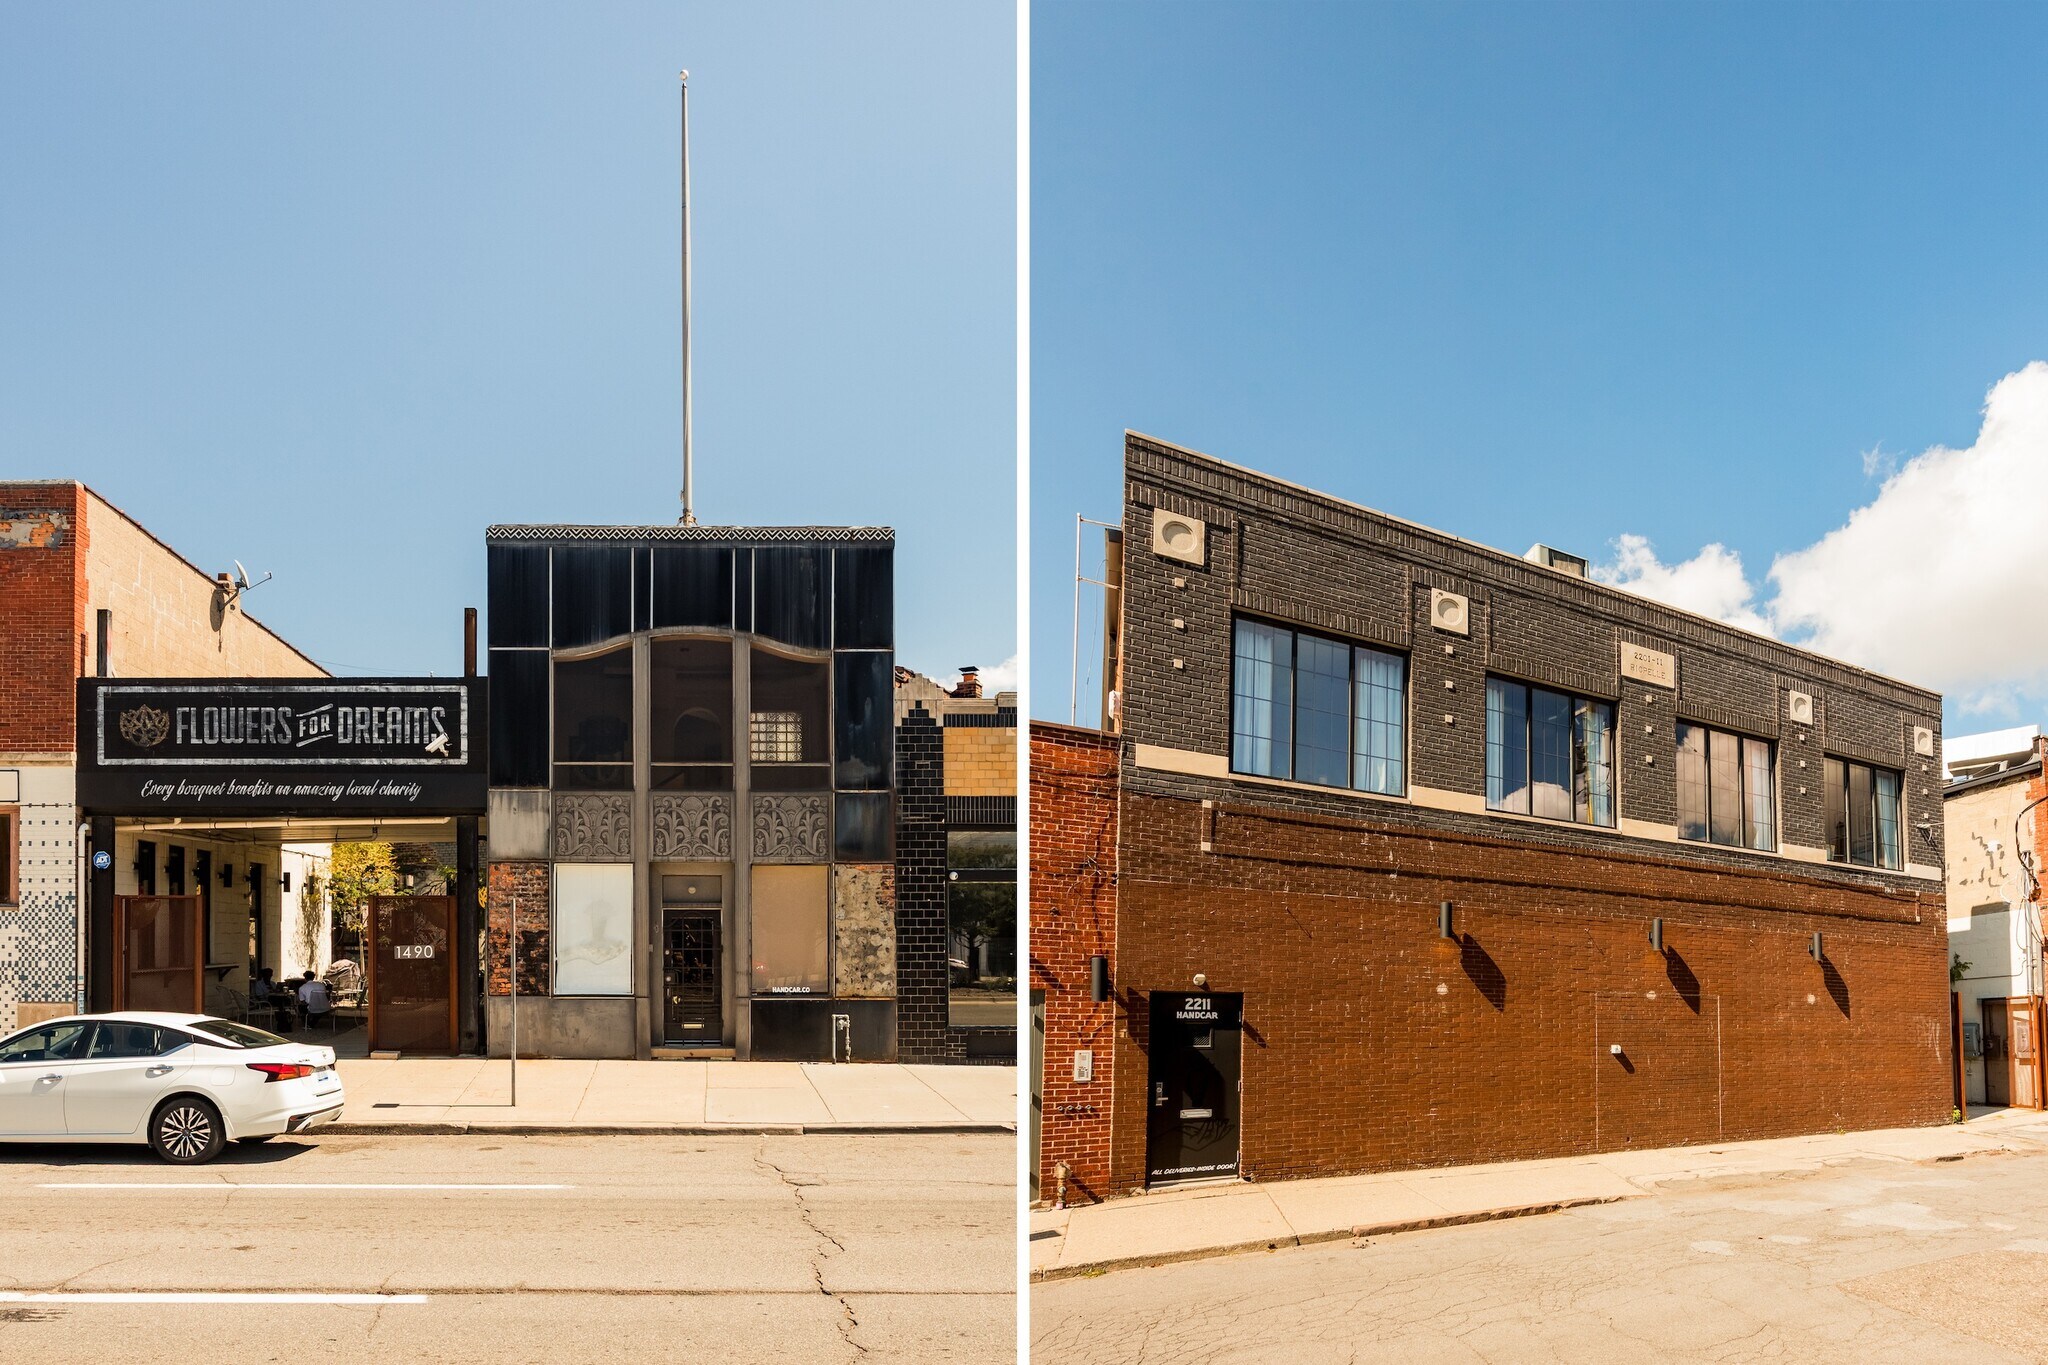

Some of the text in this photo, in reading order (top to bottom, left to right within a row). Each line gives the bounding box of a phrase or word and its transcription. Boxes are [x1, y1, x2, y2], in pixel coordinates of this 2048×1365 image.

[1634, 652, 1663, 666] 2201-11
[176, 706, 446, 744] FLOWERS FOR DREAMS
[140, 778, 422, 801] Every bouquet benefits an amazing local charity
[396, 945, 433, 959] 1490
[1184, 997, 1211, 1011] 2211
[1176, 1011, 1218, 1020] HANDCAR
[1216, 1162, 1237, 1170] DOOR!
